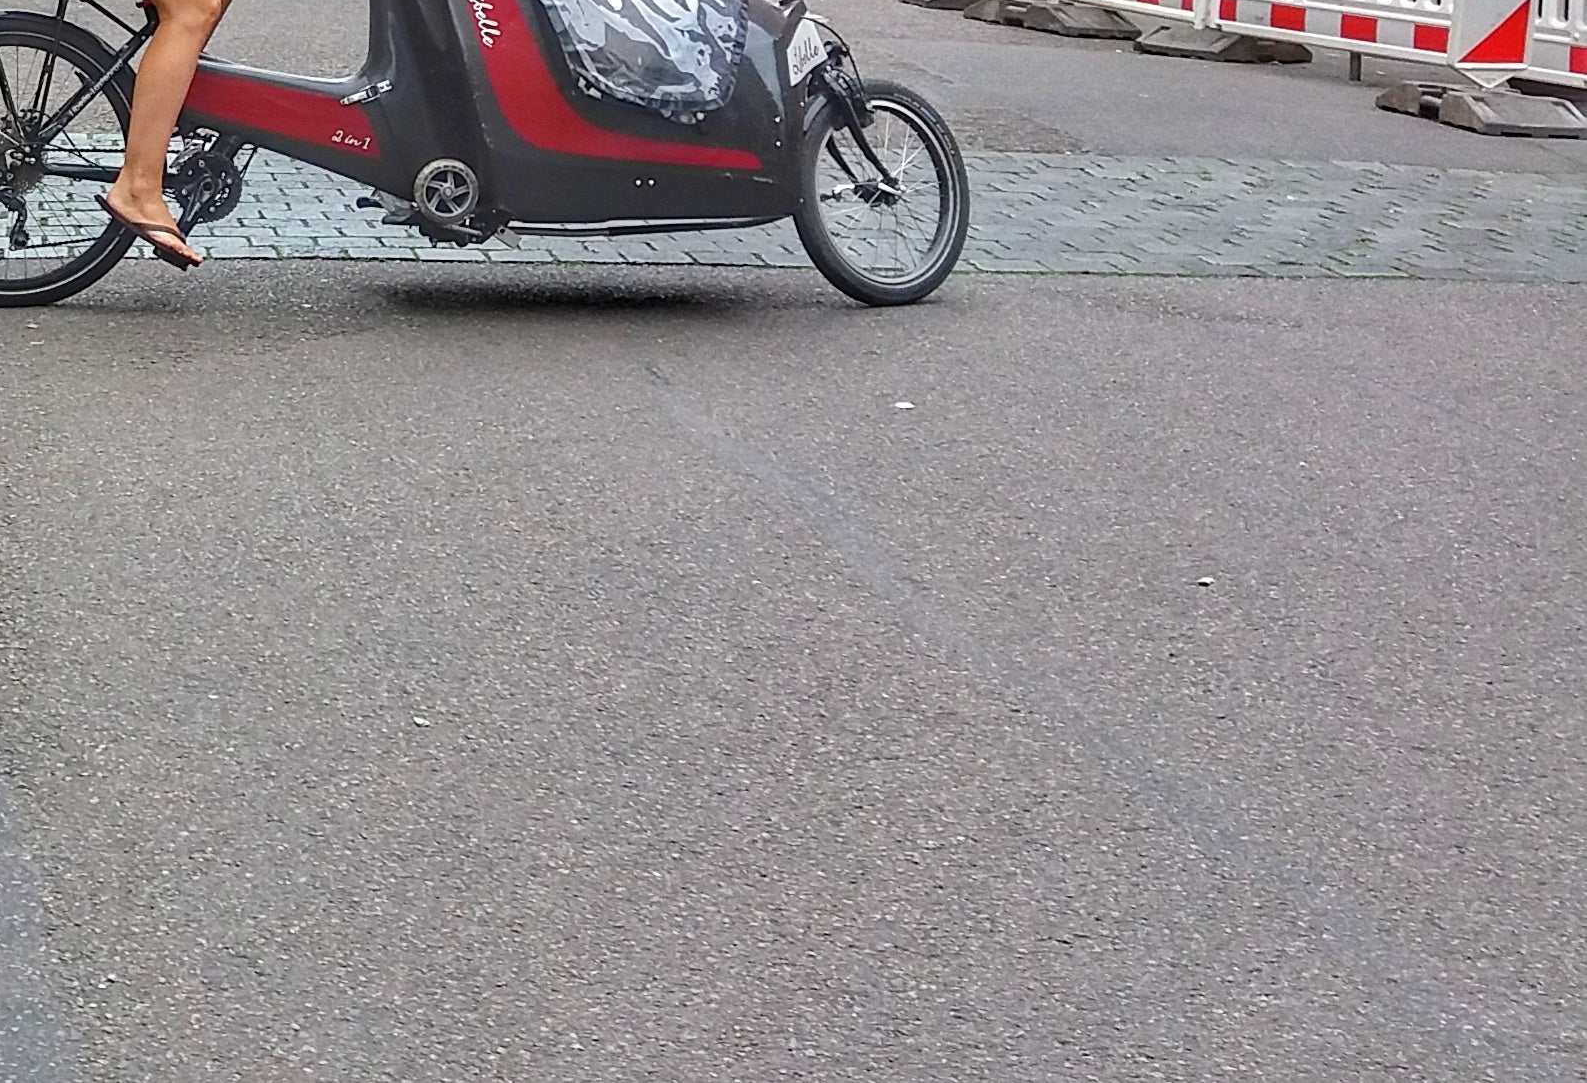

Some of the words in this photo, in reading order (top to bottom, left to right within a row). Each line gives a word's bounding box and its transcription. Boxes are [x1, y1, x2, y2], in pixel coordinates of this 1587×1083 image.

[793, 36, 820, 75] Libelle
[331, 129, 344, 143] 2
[344, 134, 363, 147] in
[362, 137, 372, 150] 1
